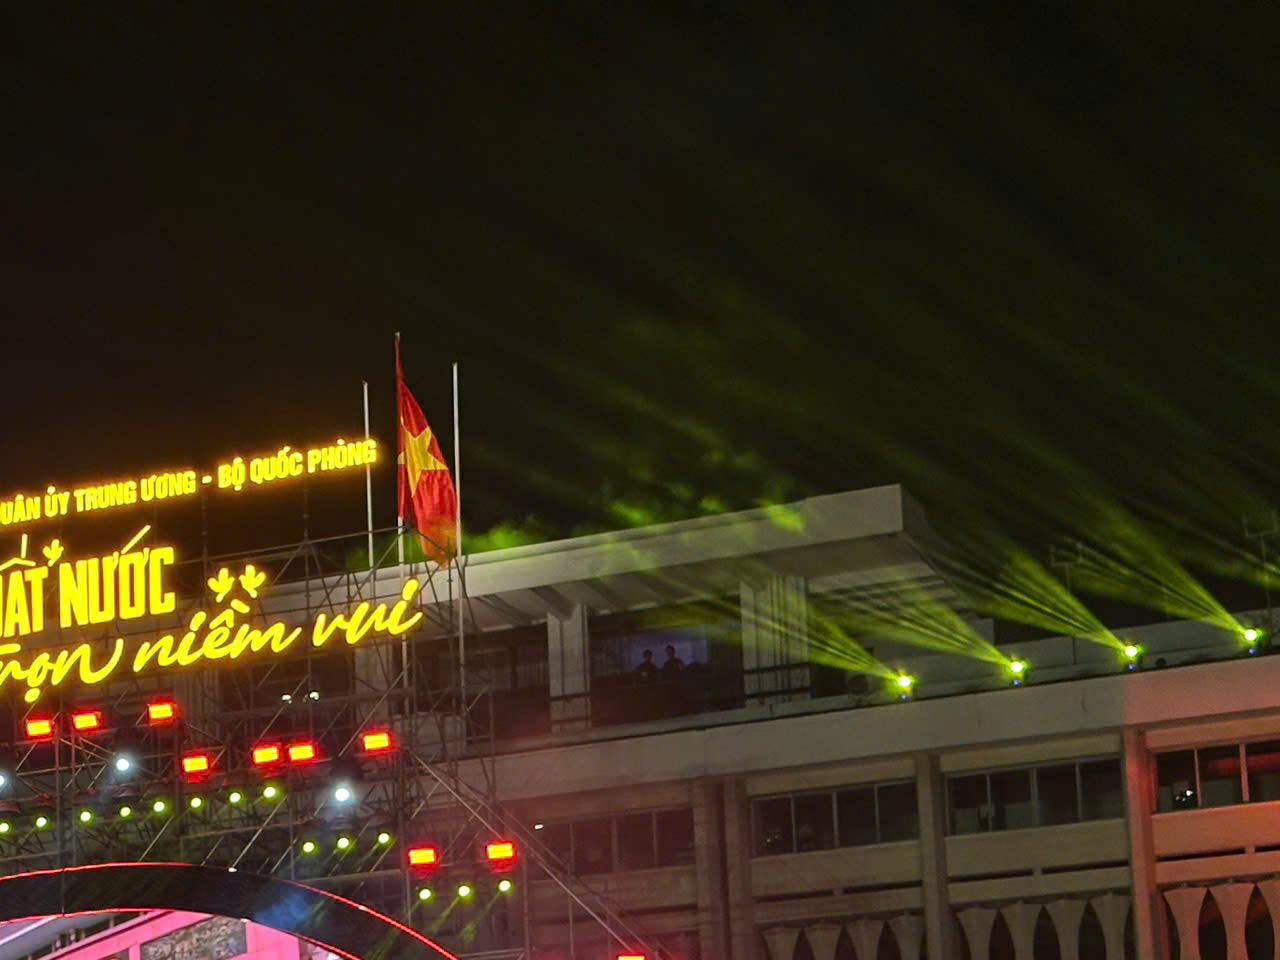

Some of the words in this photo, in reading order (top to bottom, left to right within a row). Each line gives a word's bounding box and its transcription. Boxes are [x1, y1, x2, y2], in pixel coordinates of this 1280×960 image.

[44, 485, 70, 518] ỦY
[73, 480, 138, 513] TRUNG
[140, 470, 197, 502] ƯƠNG
[218, 456, 246, 491] BỘ
[249, 445, 304, 485] QUỐC
[307, 438, 378, 474] PHÒNG
[58, 524, 177, 631] NƯỚC
[133, 600, 303, 673] niềm
[312, 577, 424, 648] vui
